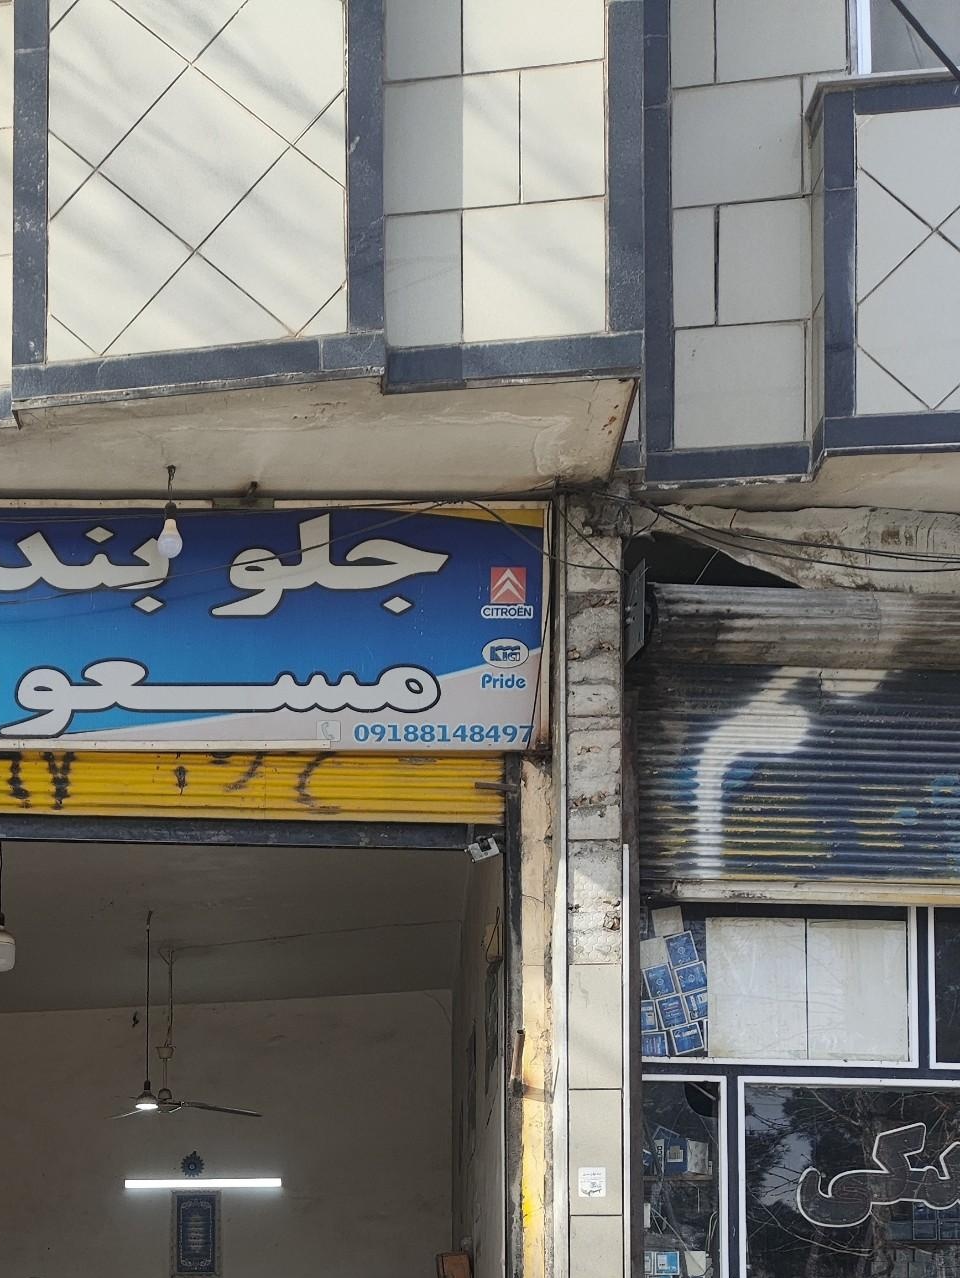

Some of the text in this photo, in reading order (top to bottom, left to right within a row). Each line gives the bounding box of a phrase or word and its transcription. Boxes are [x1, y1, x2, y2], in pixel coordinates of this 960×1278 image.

[481, 605, 533, 618] CITROËN
[481, 673, 527, 690] Pride
[353, 722, 534, 744] 09188148497
